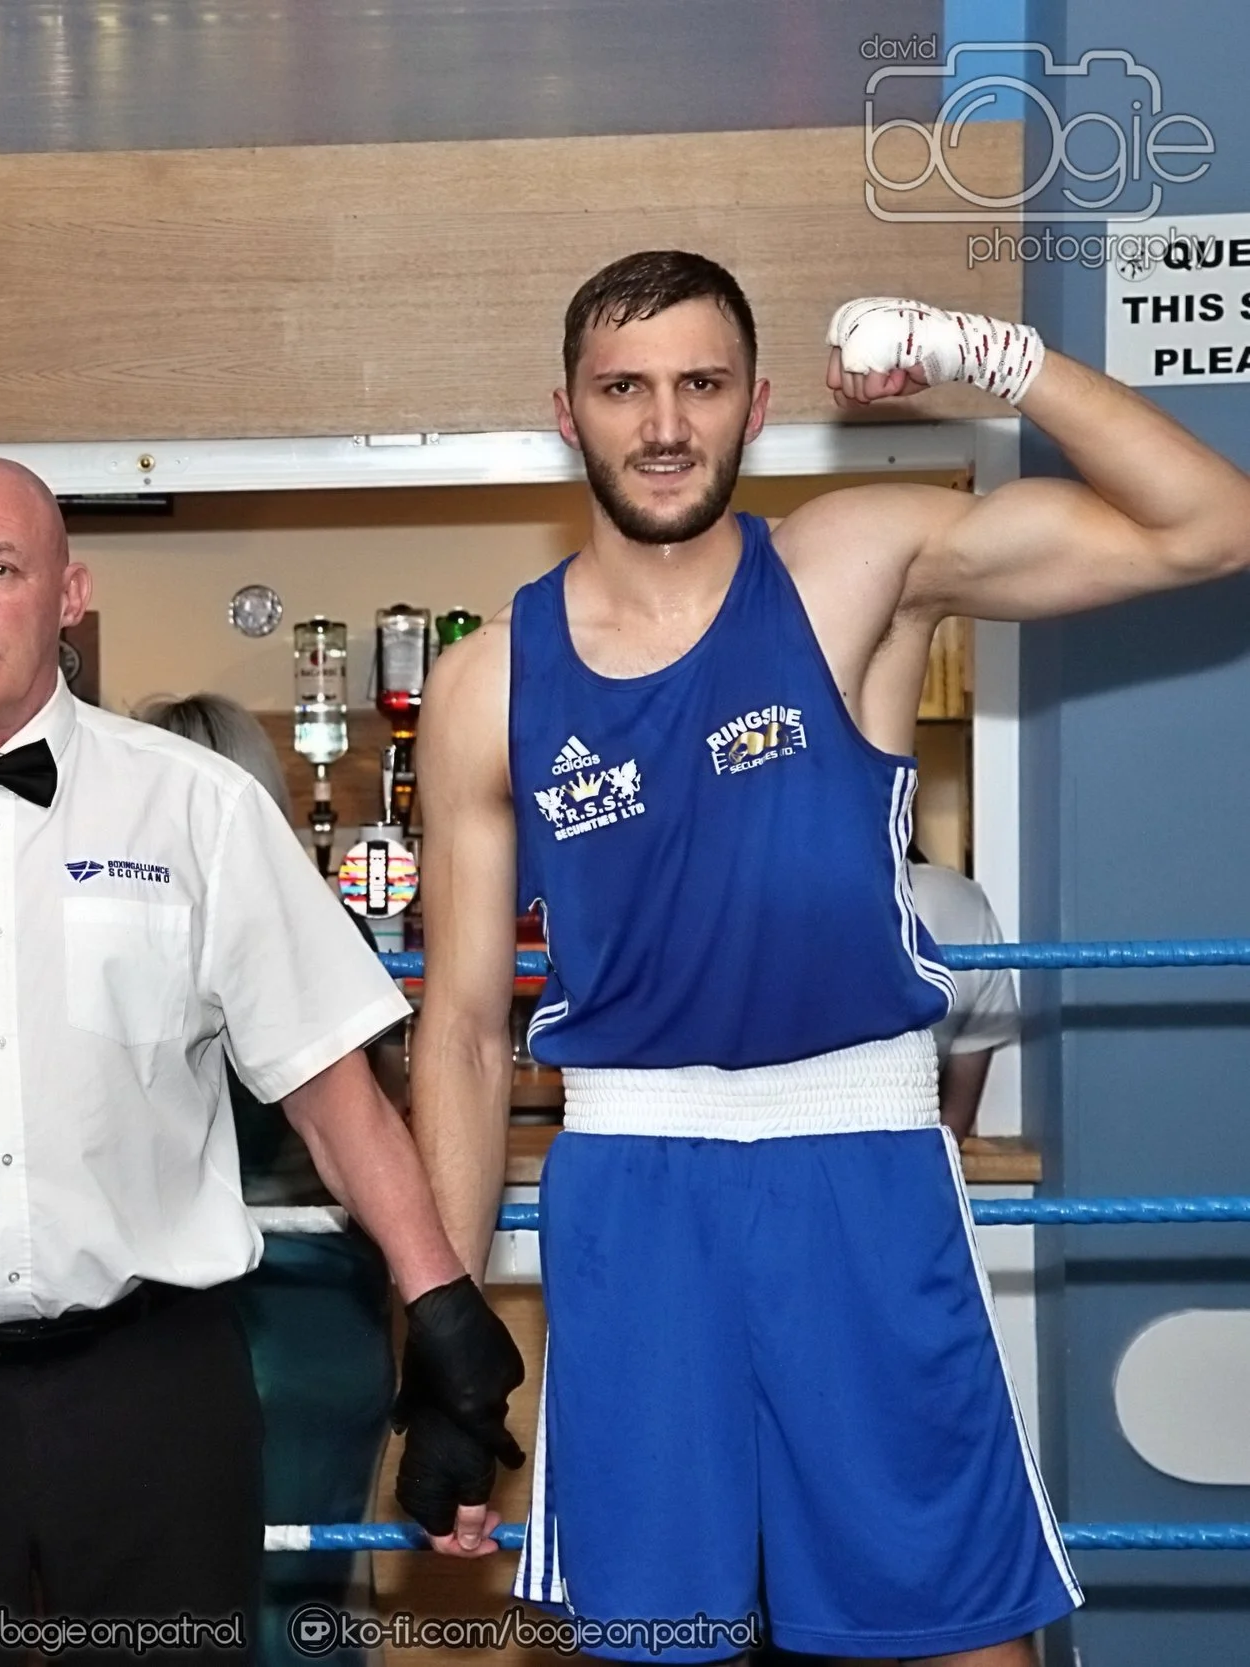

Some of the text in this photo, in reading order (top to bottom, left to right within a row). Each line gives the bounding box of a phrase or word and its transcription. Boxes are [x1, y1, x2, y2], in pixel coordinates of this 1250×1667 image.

[1122, 293, 1224, 324] THIS
[706, 705, 802, 752] RINGSIDE
[551, 754, 601, 776] adidas
[565, 795, 623, 824] R.S.S.
[620, 802, 645, 819] LTD
[107, 860, 170, 875] BOXINGALLIANCE
[108, 868, 170, 883] SCOTLAND
